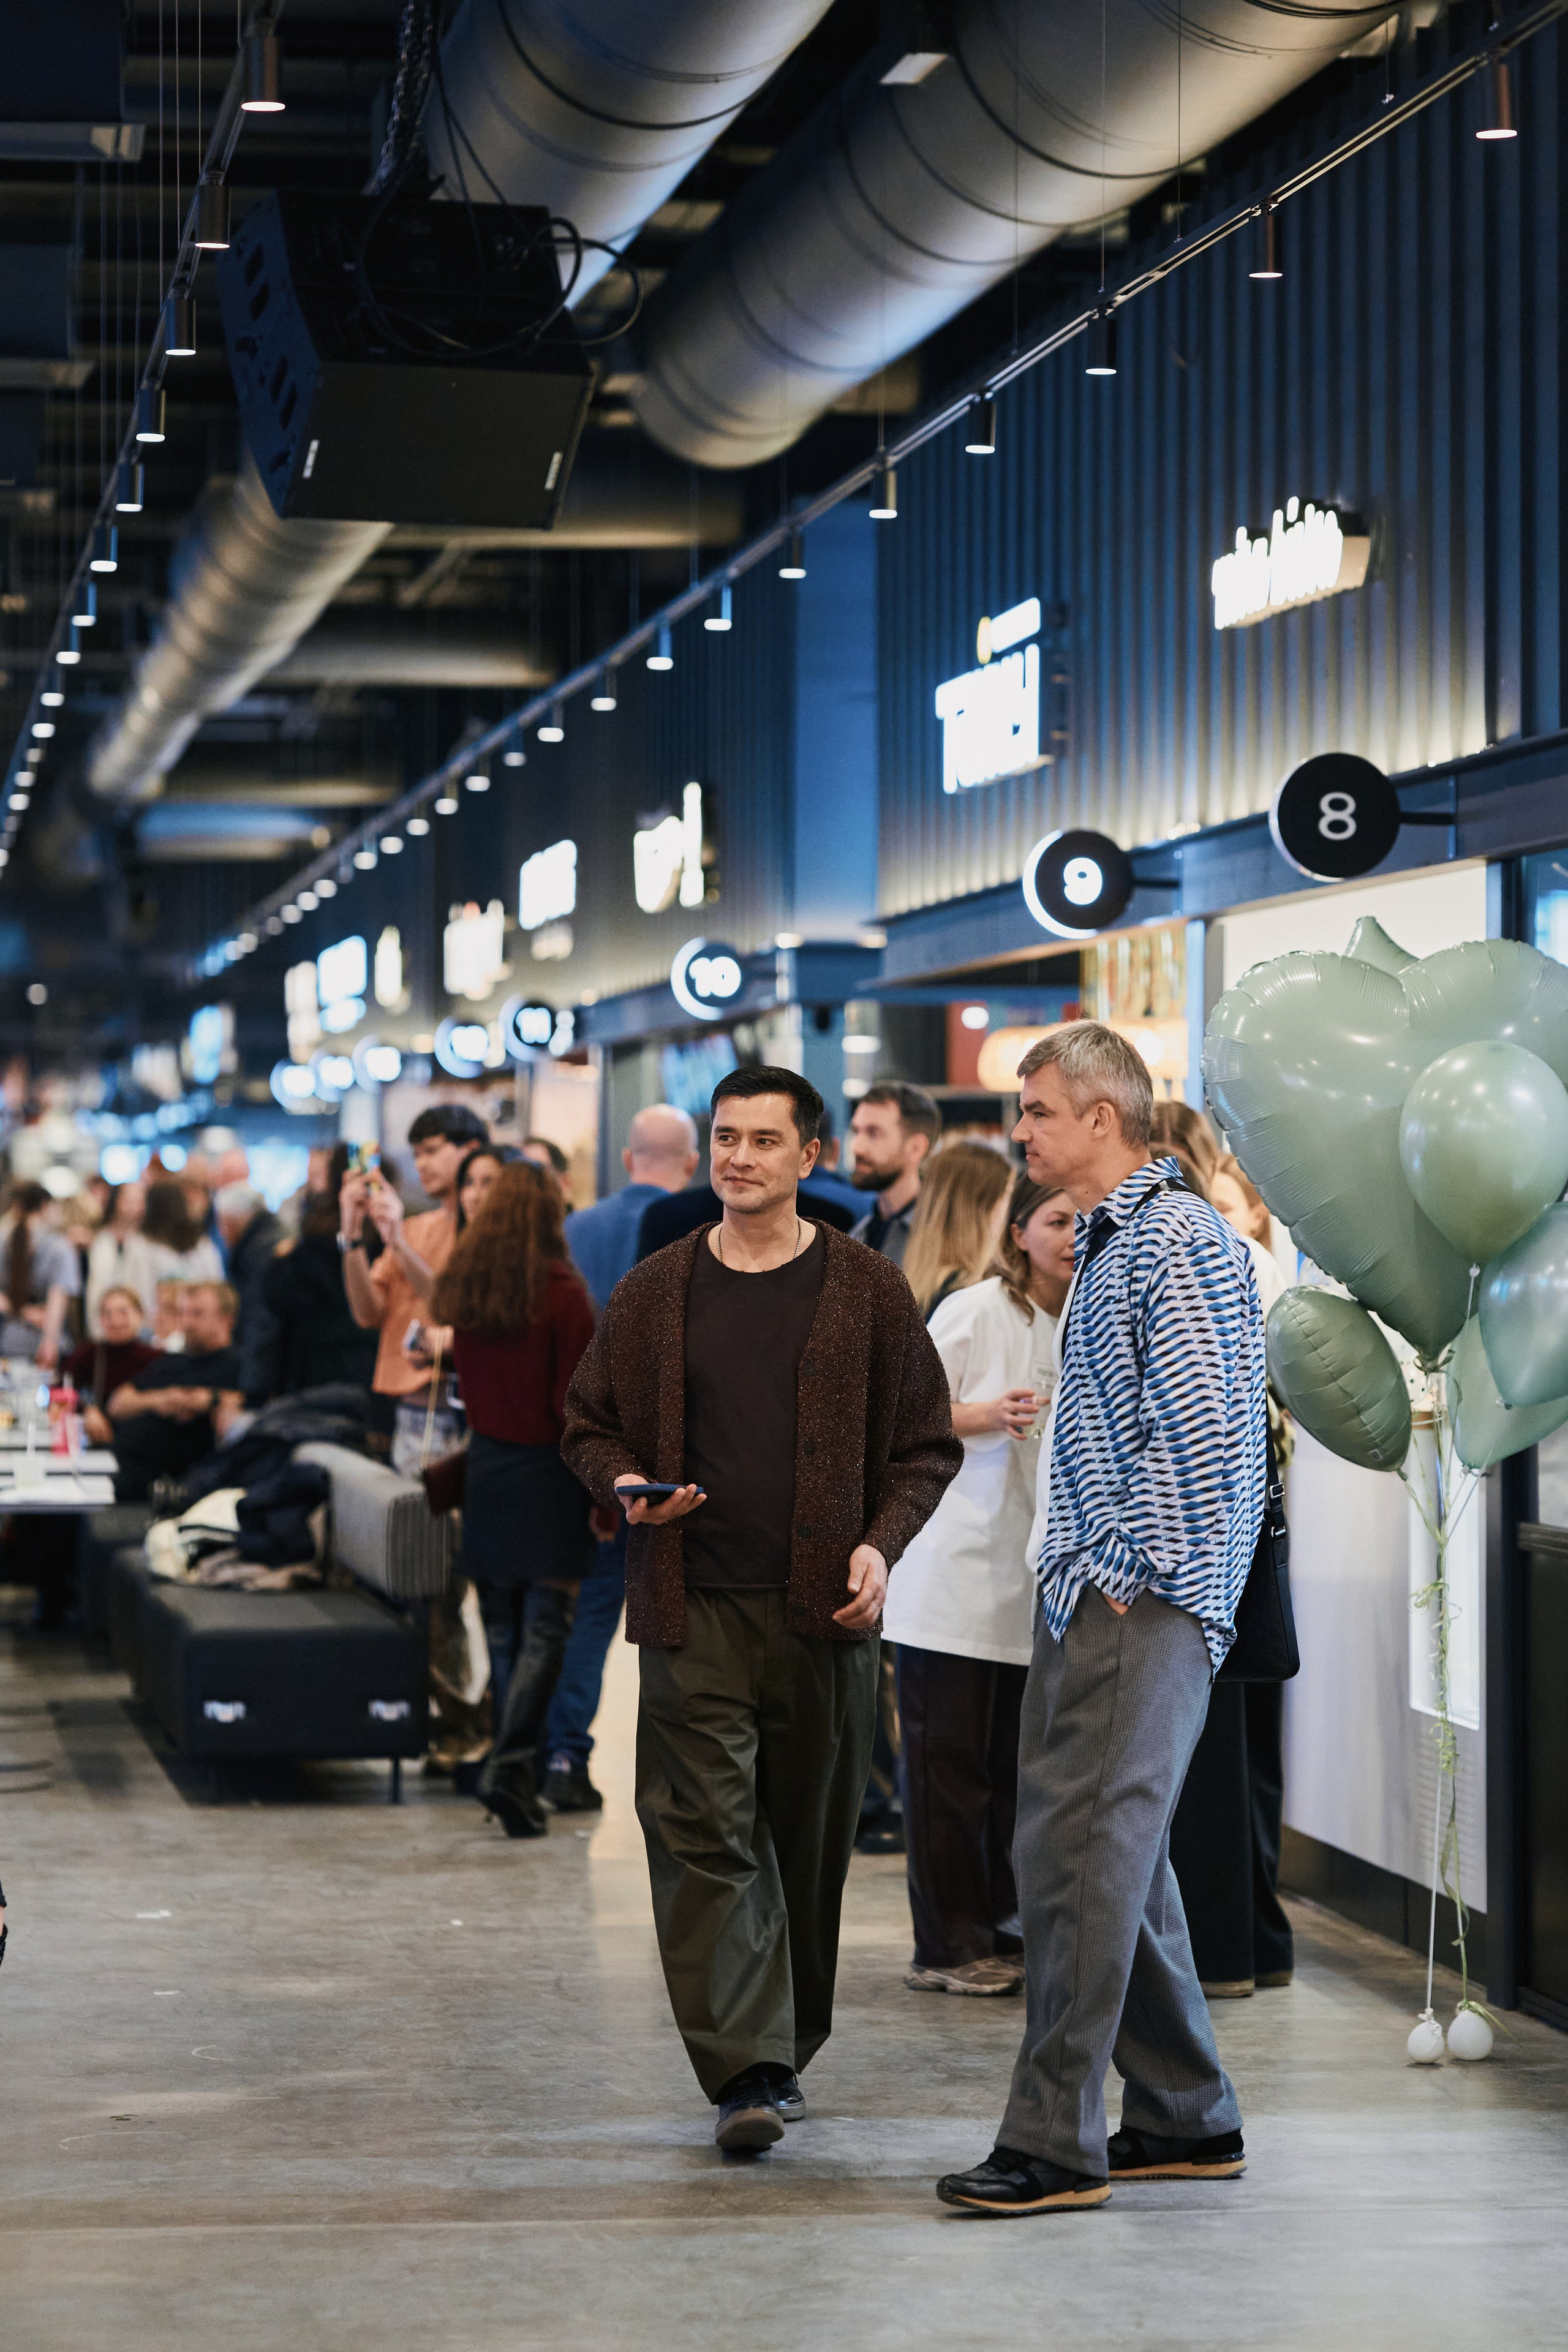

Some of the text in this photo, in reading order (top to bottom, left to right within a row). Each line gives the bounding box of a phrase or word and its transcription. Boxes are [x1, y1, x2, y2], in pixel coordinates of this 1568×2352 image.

[1319, 792, 1357, 840] 8
[1063, 857, 1103, 905] 9
[689, 956, 741, 998] 10
